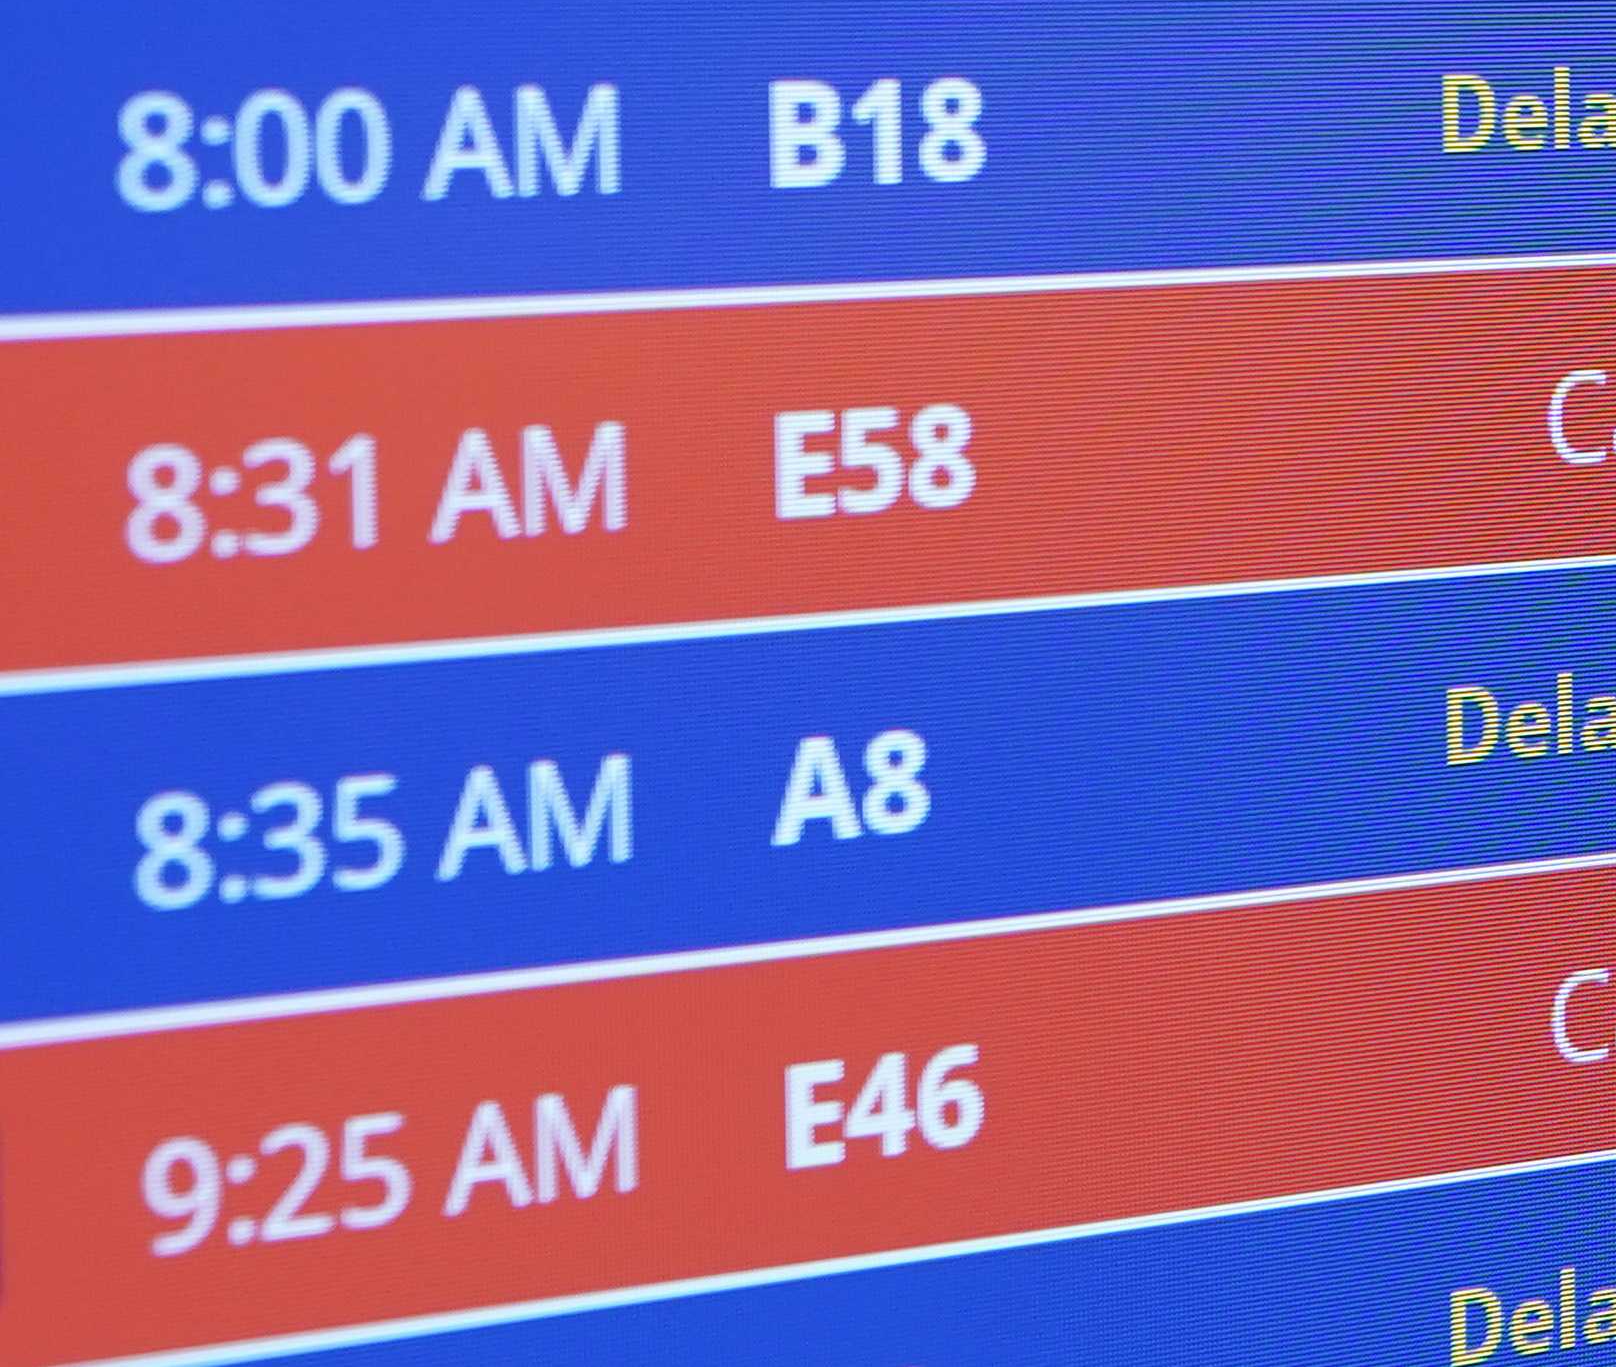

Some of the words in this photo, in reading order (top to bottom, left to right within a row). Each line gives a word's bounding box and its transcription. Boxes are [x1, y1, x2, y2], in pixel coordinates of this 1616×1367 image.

[117, 89, 391, 212] 8:00
[423, 84, 620, 201] AM
[769, 77, 986, 189] B18
[127, 435, 376, 562] 8:31
[431, 421, 625, 542] AM
[774, 403, 976, 519] E58
[135, 775, 404, 910] 8:35
[437, 754, 631, 880] AM
[772, 730, 930, 847] A8
[785, 1043, 984, 1169] E46
[143, 1112, 410, 1255] 9:25
[445, 1085, 637, 1215] AM
